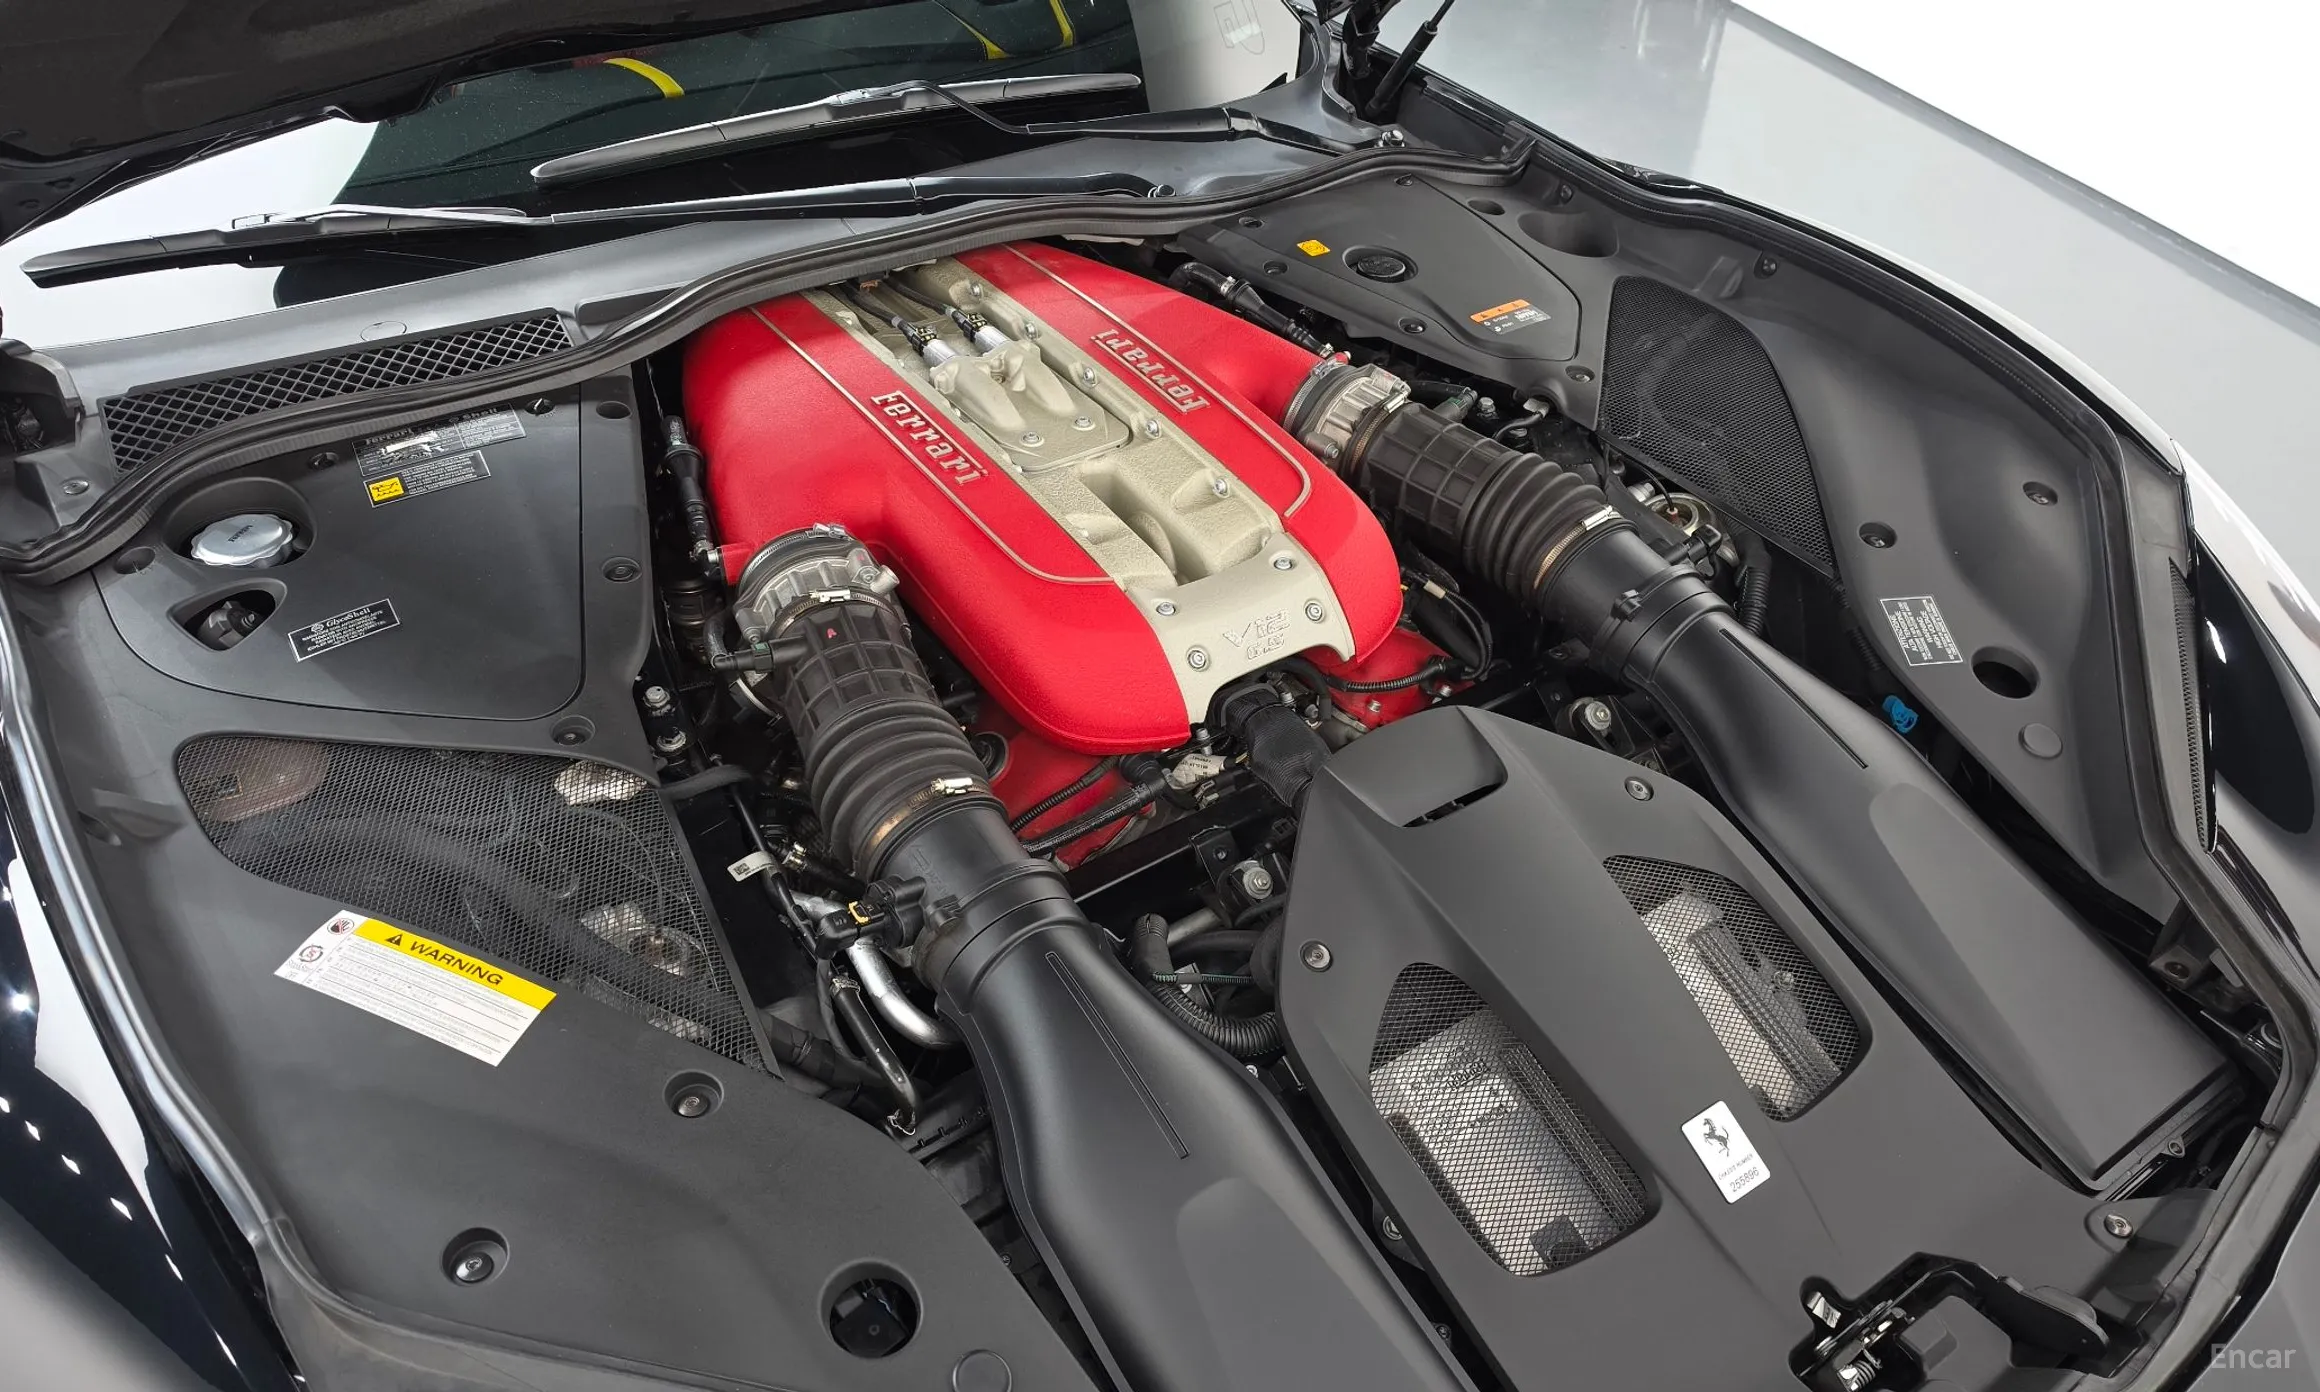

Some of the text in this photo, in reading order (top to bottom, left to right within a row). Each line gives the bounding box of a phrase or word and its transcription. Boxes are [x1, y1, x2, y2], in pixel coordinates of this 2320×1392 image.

[1090, 329, 1210, 414] Ferrari
[870, 390, 988, 485] Ferrari
[410, 941, 504, 986] WARNING
[1729, 1166, 1760, 1192] 255896
